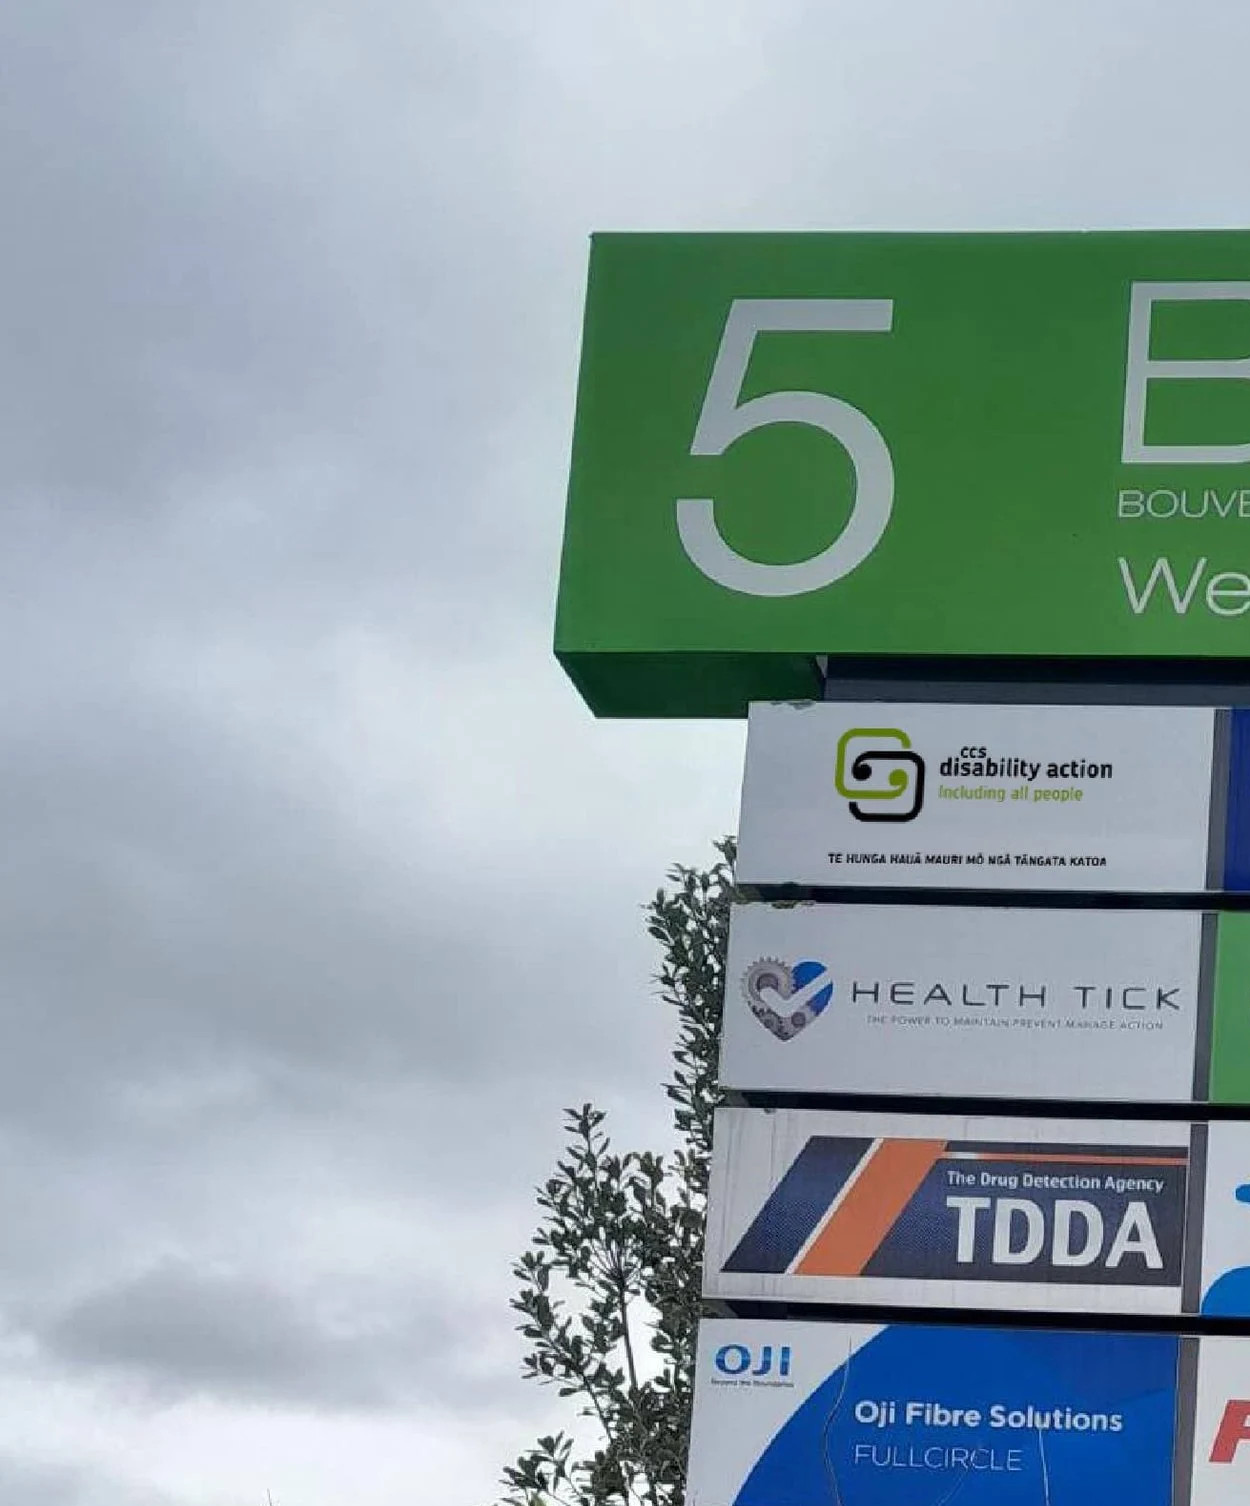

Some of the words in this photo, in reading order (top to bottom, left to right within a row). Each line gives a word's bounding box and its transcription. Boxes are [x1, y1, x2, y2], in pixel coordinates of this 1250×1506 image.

[675, 298, 895, 596] 5
[960, 746, 987, 758] ccs
[939, 758, 1042, 781] disability
[1047, 761, 1113, 780] action
[1011, 786, 1029, 801] all
[1033, 787, 1083, 803] people
[828, 853, 842, 864] TE
[846, 853, 887, 864] HUNGA
[925, 853, 962, 865] MAURI
[1070, 856, 1107, 868] KATOA
[852, 981, 1047, 1009] HEALTH
[1074, 986, 1181, 1010] TICK
[947, 1170, 976, 1186] The
[980, 1171, 1018, 1190] Drug
[1023, 1171, 1101, 1190] Detection
[1104, 1175, 1164, 1194] Agency
[946, 1196, 1164, 1270] TDDA
[715, 1344, 790, 1376] OJI
[854, 1400, 895, 1429] Oji
[906, 1401, 981, 1429] Fibre
[990, 1405, 1123, 1432] Solutions
[854, 1445, 1023, 1471] FULLCIRCLE
